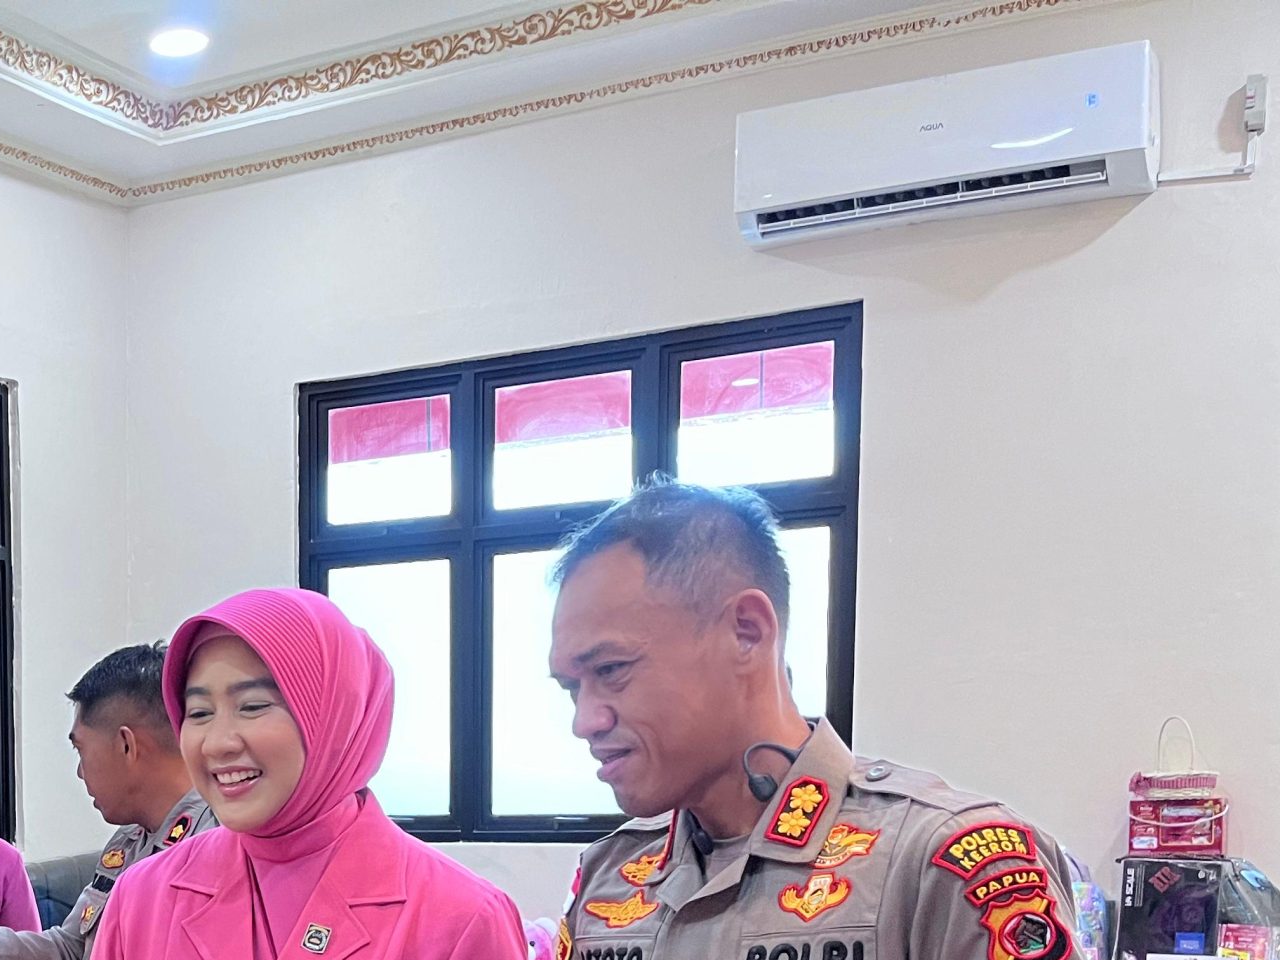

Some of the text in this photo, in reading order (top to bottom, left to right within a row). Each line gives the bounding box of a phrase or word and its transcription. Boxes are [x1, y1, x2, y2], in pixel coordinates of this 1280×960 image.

[919, 122, 944, 132] AQUA
[949, 828, 1021, 859] POLRES
[959, 841, 1027, 870] KEEROM
[975, 871, 1041, 899] PAPUA
